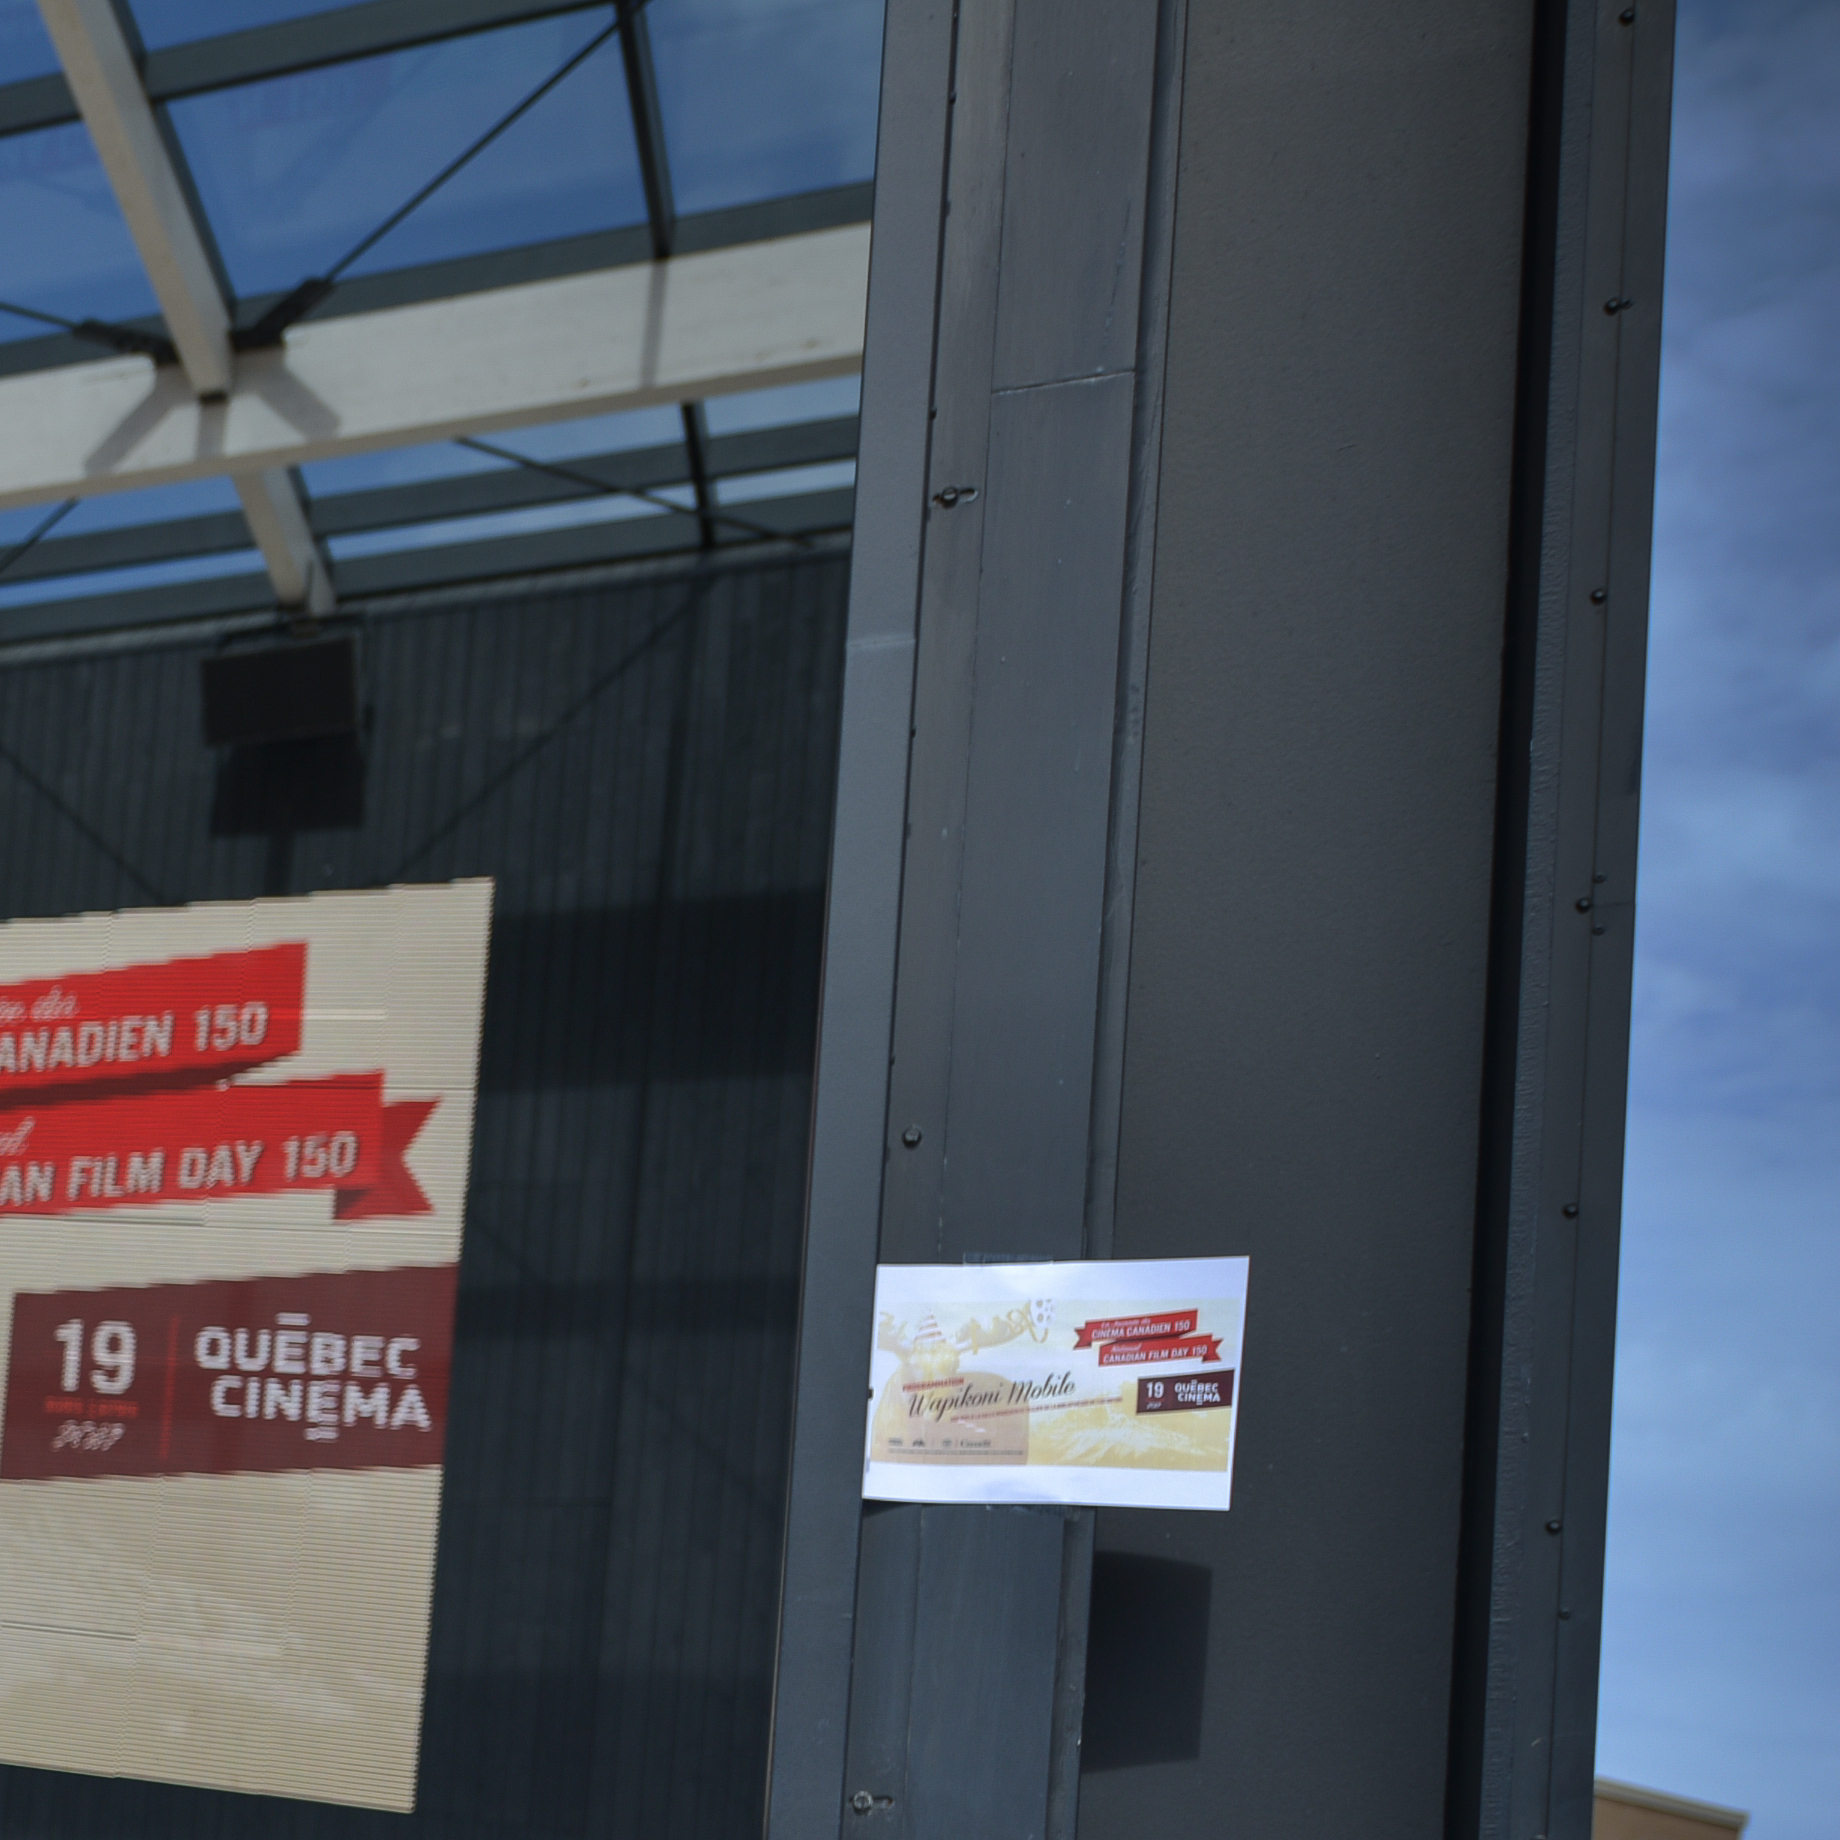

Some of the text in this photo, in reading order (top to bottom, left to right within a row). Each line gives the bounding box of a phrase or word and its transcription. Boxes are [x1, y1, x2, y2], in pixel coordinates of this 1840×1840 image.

[192, 1001, 270, 1052] 150
[66, 1151, 165, 1202] FILM
[177, 1140, 265, 1190] DAY
[280, 1130, 360, 1182] 150
[1126, 1323, 1171, 1337] CANADIEN
[1174, 1319, 1191, 1332] 150
[53, 1317, 138, 1396] 19
[1103, 1345, 1208, 1364] CANADIAN FILM DAY 150
[908, 1383, 1003, 1423] Wapikoni
[1008, 1372, 1075, 1405] Mobile
[1146, 1381, 1164, 1398] 19
